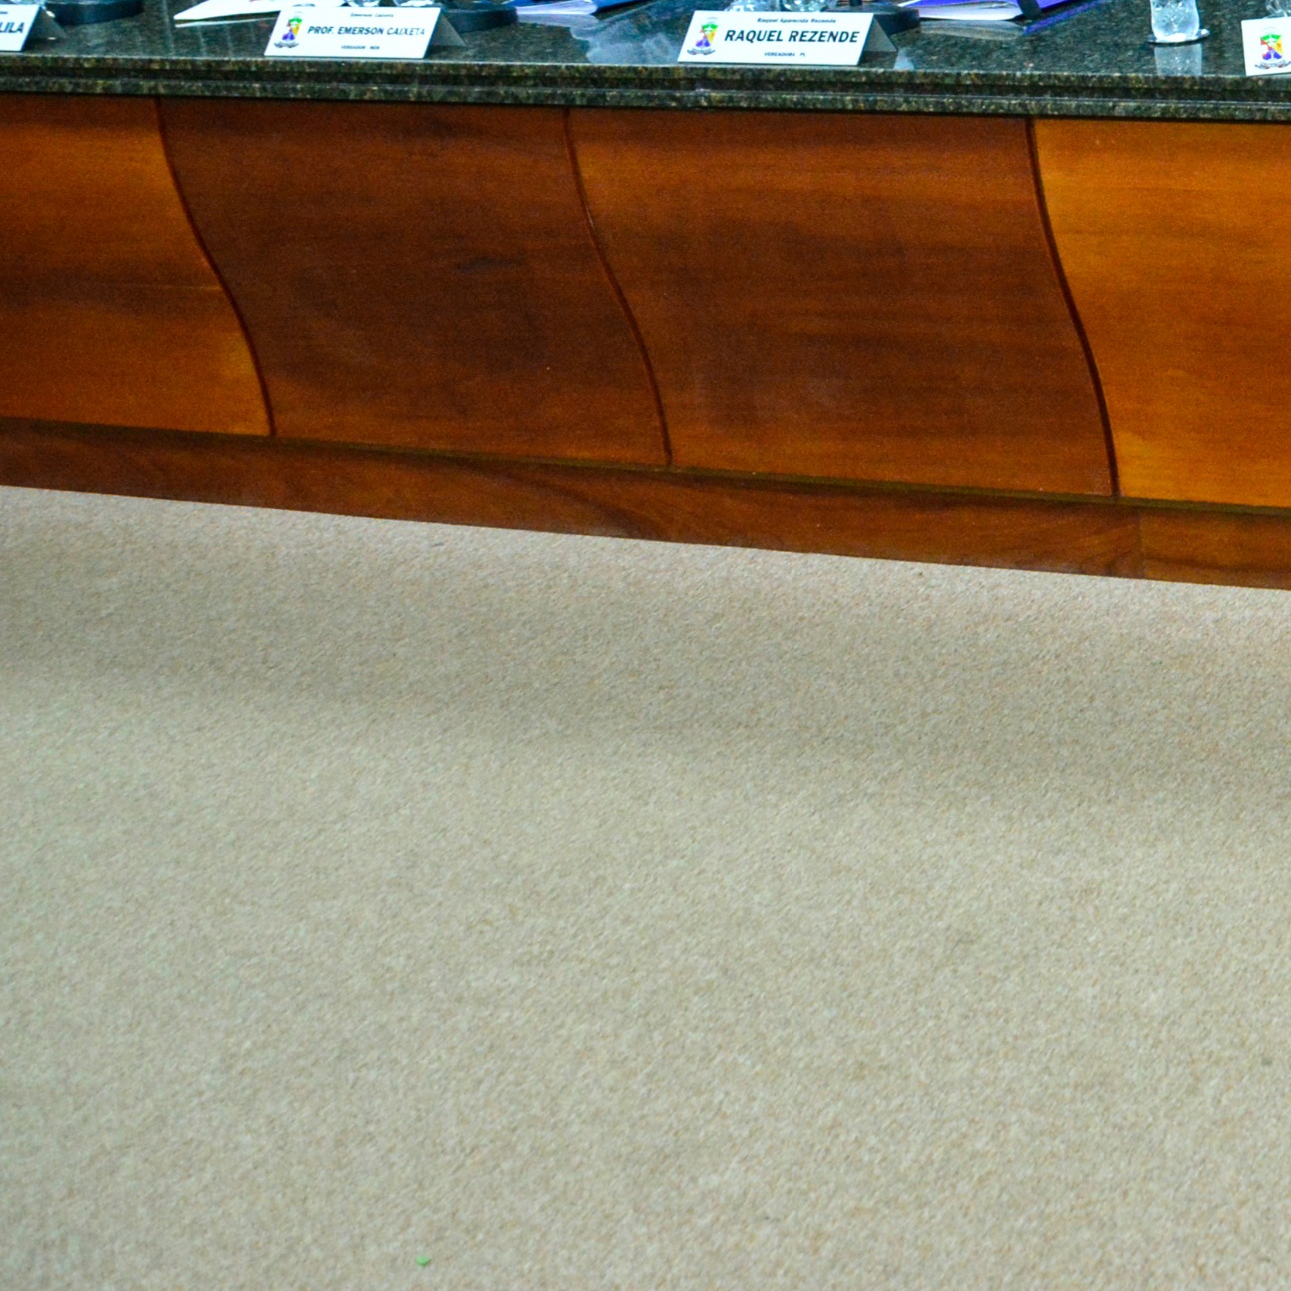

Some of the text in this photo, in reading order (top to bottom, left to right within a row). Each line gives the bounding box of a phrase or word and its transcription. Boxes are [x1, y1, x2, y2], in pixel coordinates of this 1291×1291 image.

[307, 26, 426, 36] PROF. EMERSON CAIXETA
[724, 29, 860, 44] RAQUEL REZENDE
